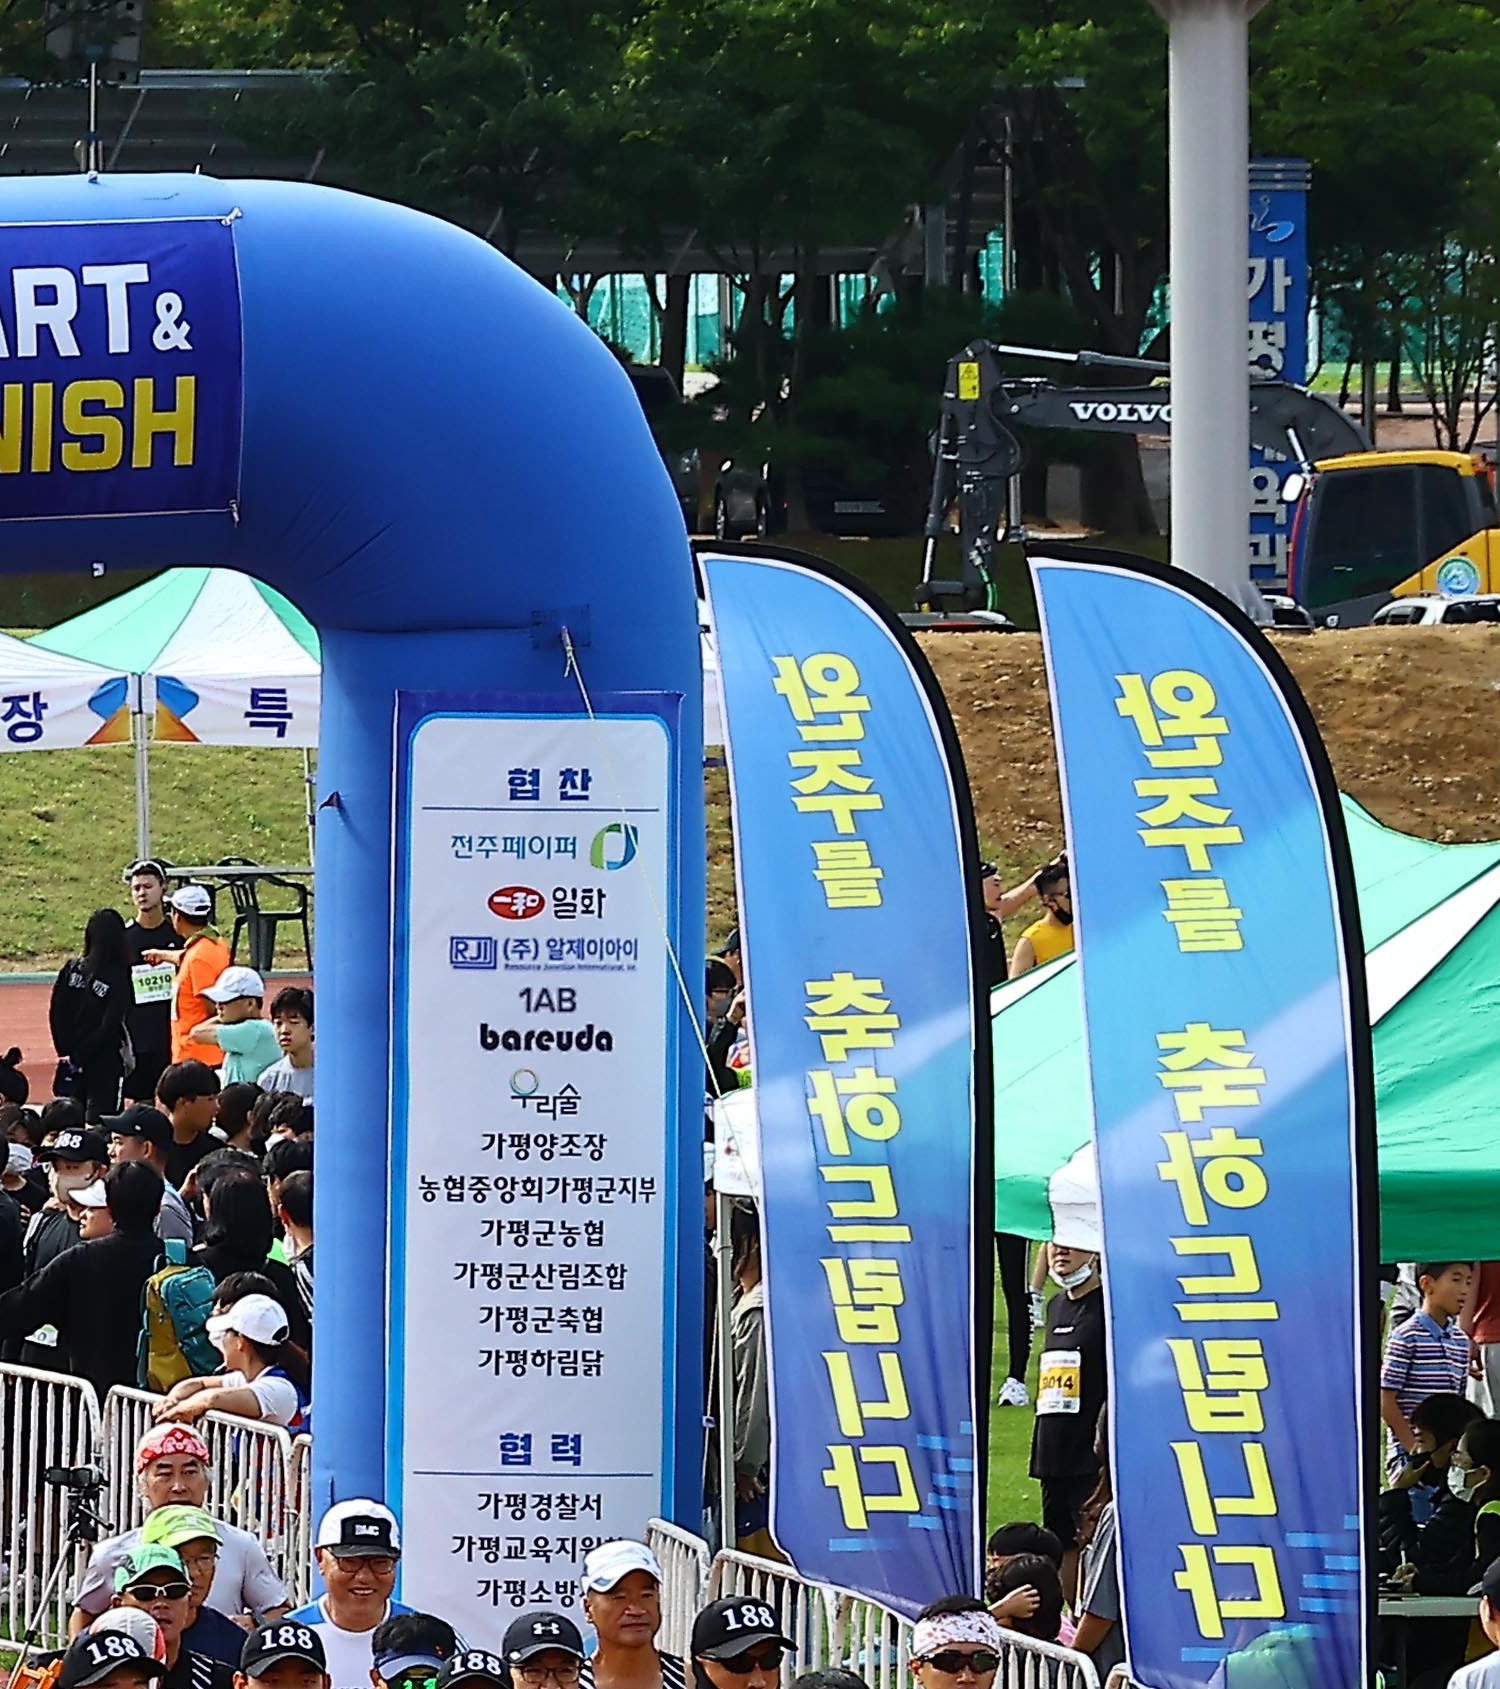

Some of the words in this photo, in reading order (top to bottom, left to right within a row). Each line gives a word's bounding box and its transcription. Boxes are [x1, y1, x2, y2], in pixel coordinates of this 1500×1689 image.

[451, 835, 577, 860] 전주페이퍼
[552, 886, 607, 920] 일화
[502, 937, 540, 962] (주)
[545, 937, 638, 962] 알제이아이
[518, 986, 577, 1014] 1AB
[479, 1022, 613, 1052] bareuda
[511, 1067, 582, 1122] 우리술
[481, 1132, 608, 1162] 가평양조장
[418, 1174, 657, 1205] 농협중앙회가평군지부
[480, 1219, 604, 1248] 가평군농협
[453, 1262, 628, 1291] 가평군산림조합
[479, 1305, 603, 1335] 가평군축협
[478, 1349, 605, 1378] 가평하림닭
[477, 1492, 602, 1521] 가평경찰서
[477, 1578, 585, 1607] 가평소방
[722, 1604, 775, 1631] 188
[86, 1635, 140, 1665] 188
[261, 1625, 313, 1650] 188
[450, 1648, 502, 1675] 188
